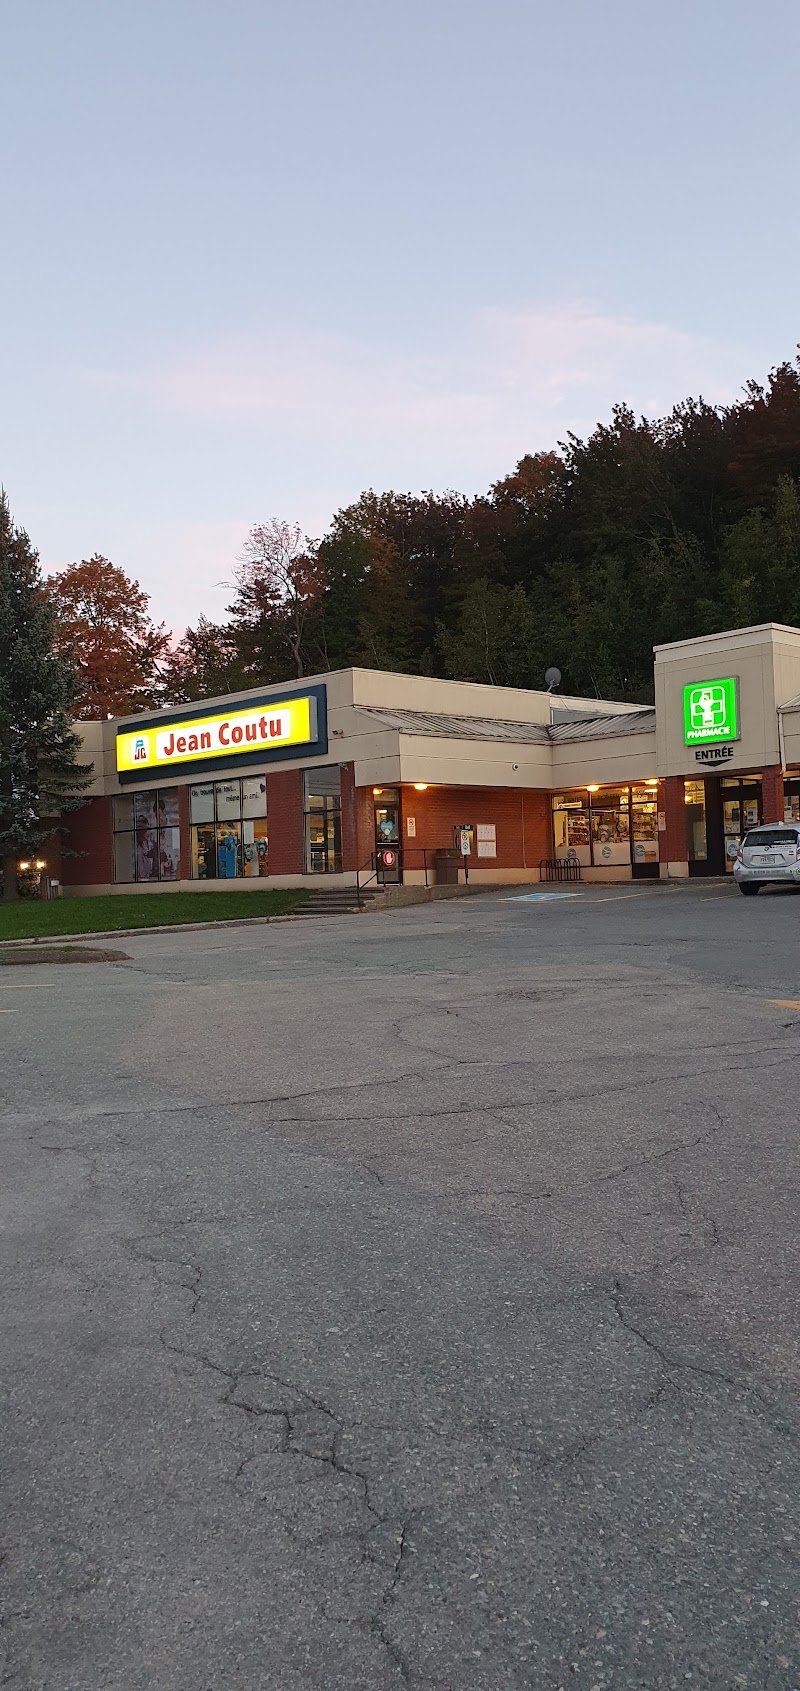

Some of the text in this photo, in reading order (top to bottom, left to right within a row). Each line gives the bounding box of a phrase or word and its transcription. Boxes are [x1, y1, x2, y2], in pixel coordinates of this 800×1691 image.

[164, 716, 282, 755] Jean Coutu
[687, 726, 730, 739] PHARMACIE
[695, 746, 734, 760] ENTRÉE
